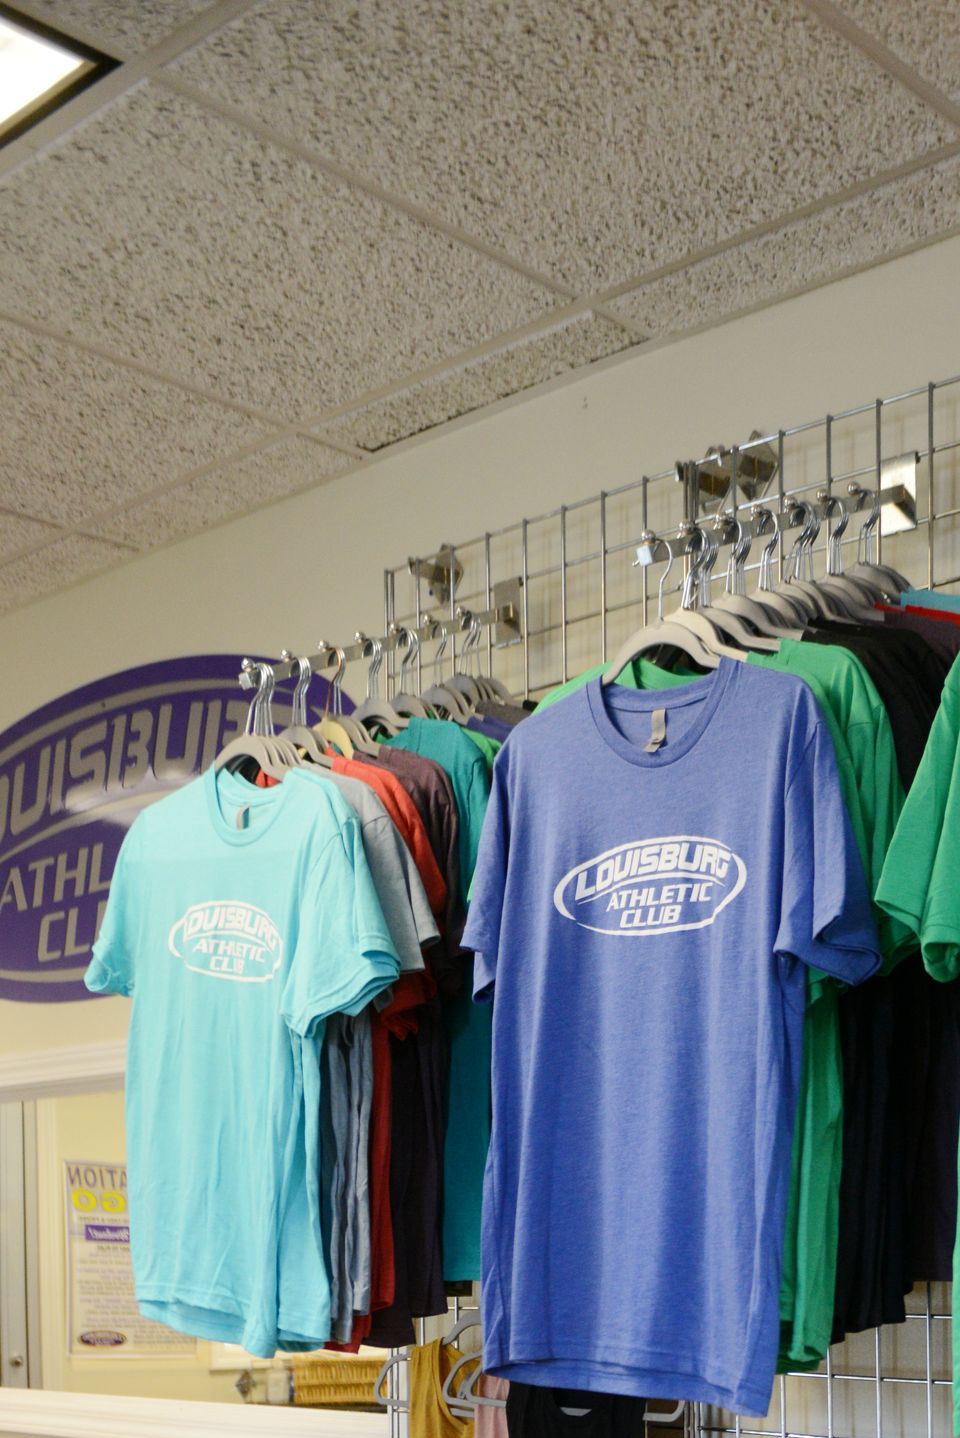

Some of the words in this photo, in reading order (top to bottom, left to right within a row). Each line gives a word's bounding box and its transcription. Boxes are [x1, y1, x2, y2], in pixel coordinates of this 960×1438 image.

[574, 843, 732, 901] LOUISBURG
[606, 882, 713, 912] ATHLETIC
[619, 905, 682, 929] CLUB
[37, 901, 107, 963] CL
